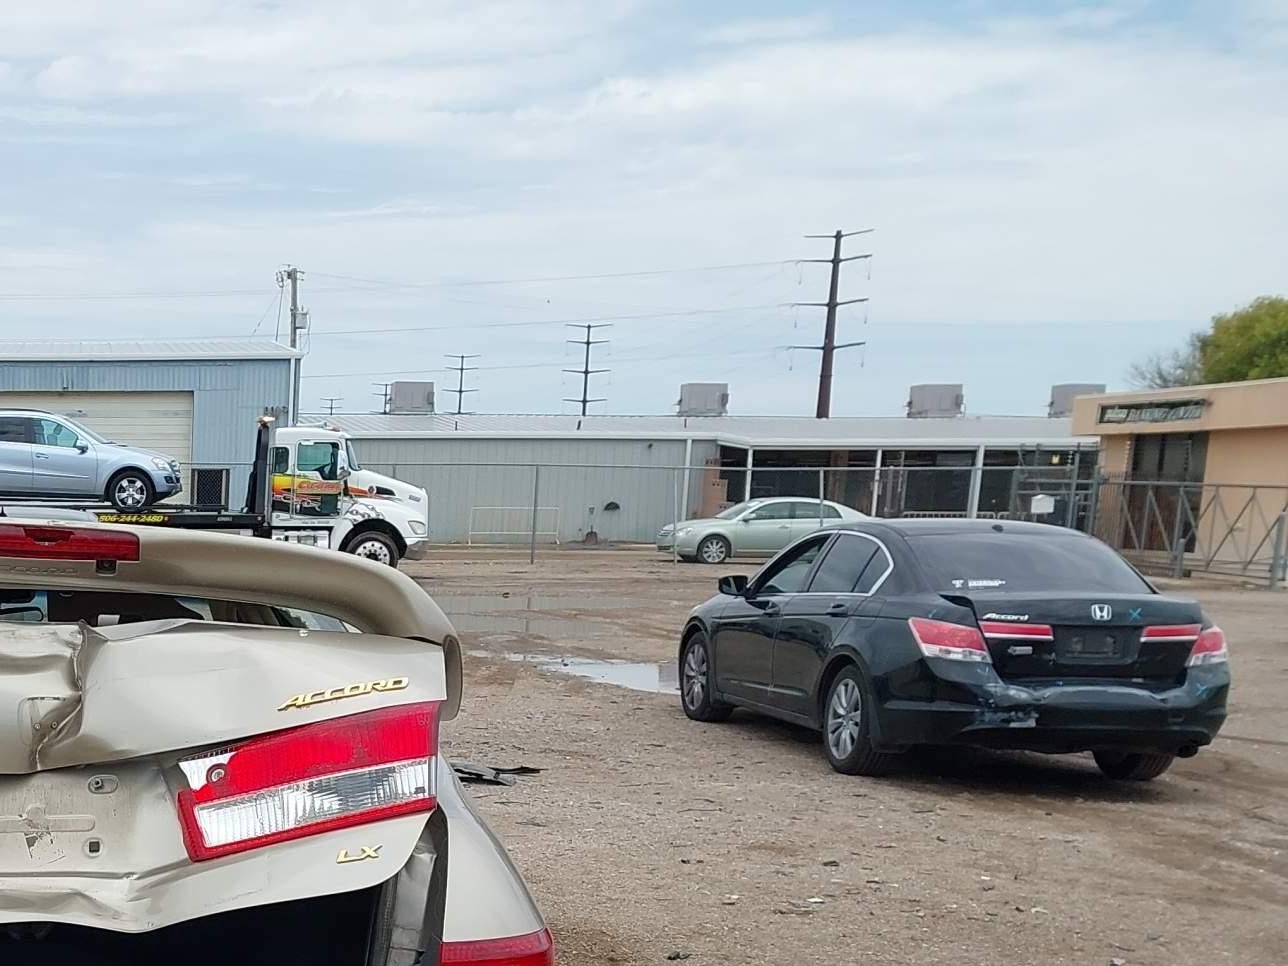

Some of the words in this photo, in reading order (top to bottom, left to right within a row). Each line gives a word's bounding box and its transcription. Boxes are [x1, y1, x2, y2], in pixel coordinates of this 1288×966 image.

[983, 612, 1029, 621] Accord
[277, 677, 409, 711] ACCORD
[336, 844, 383, 865] LX
